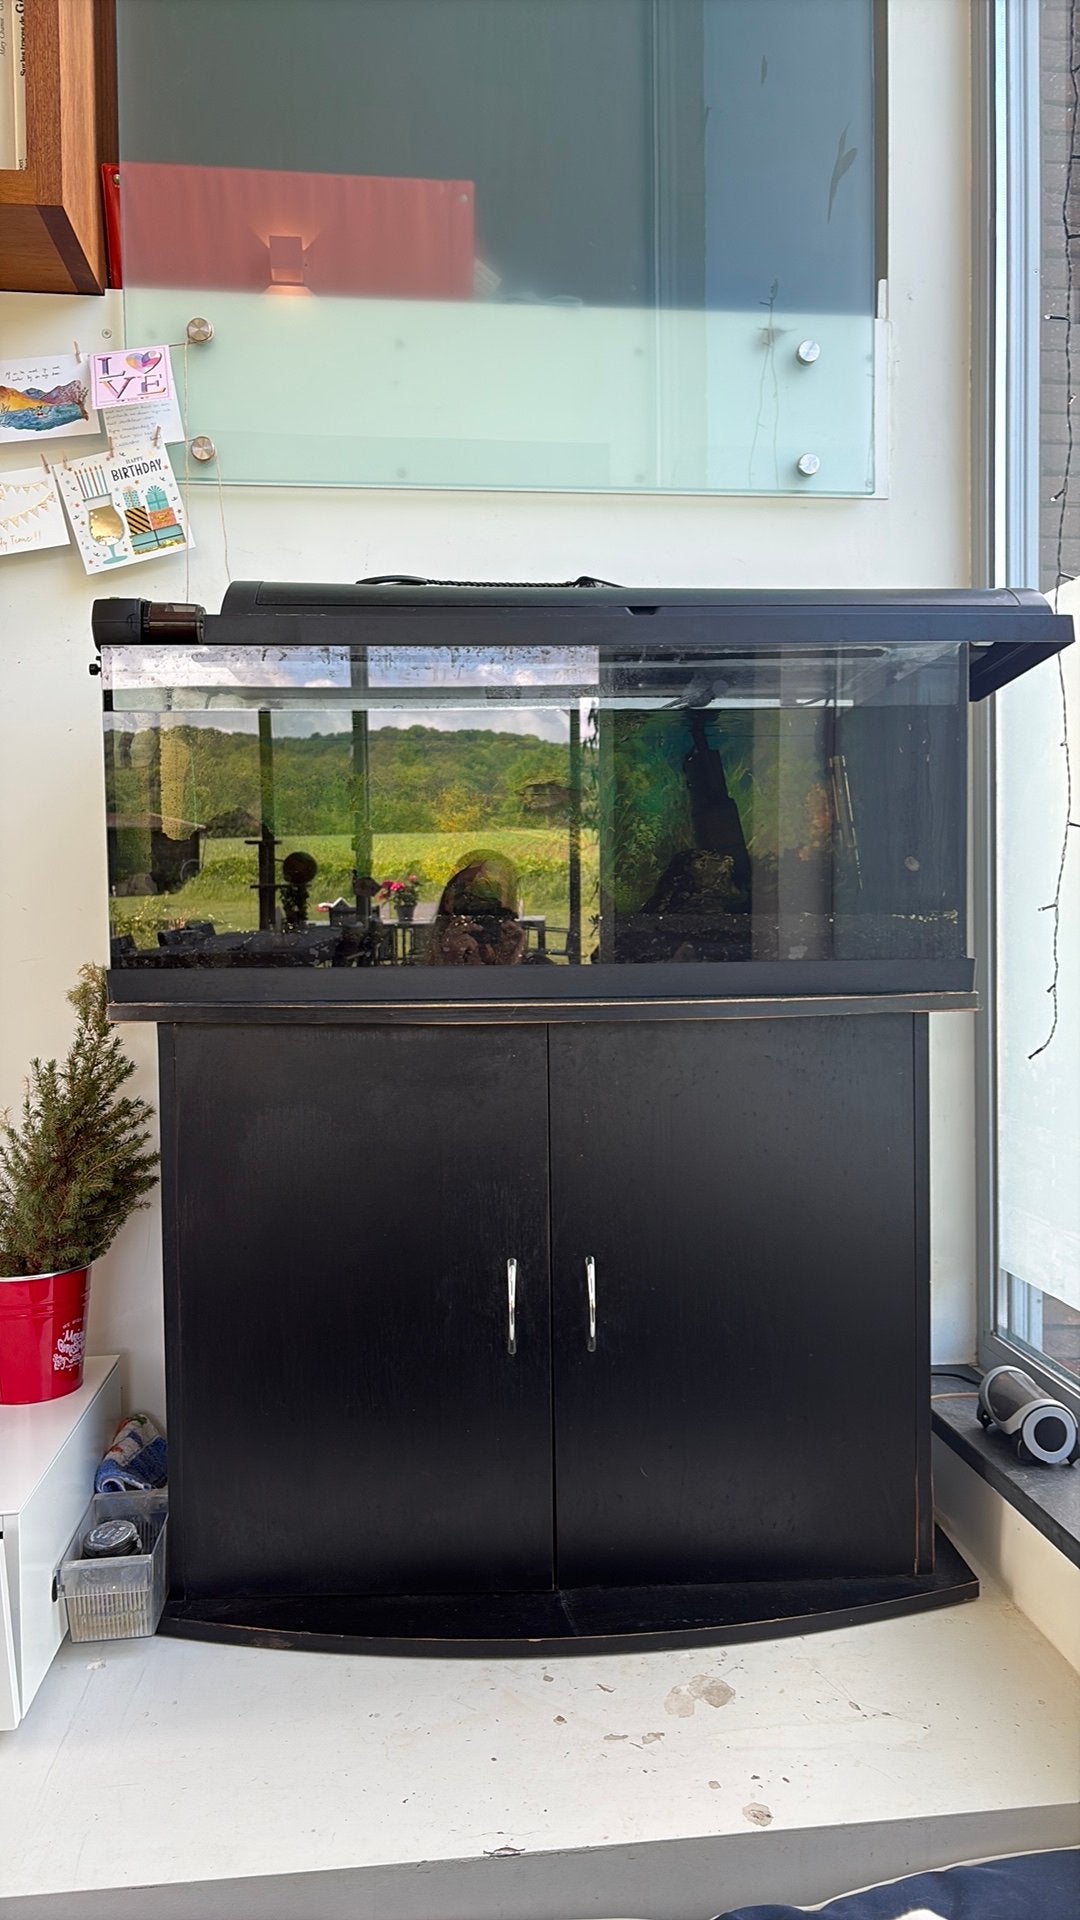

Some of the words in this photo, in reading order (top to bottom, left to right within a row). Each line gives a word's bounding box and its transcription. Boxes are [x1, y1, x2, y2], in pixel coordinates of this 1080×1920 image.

[15, 0, 25, 13] G
[125, 456, 143, 465] HAPPY
[110, 458, 162, 482] BIRTHDAY
